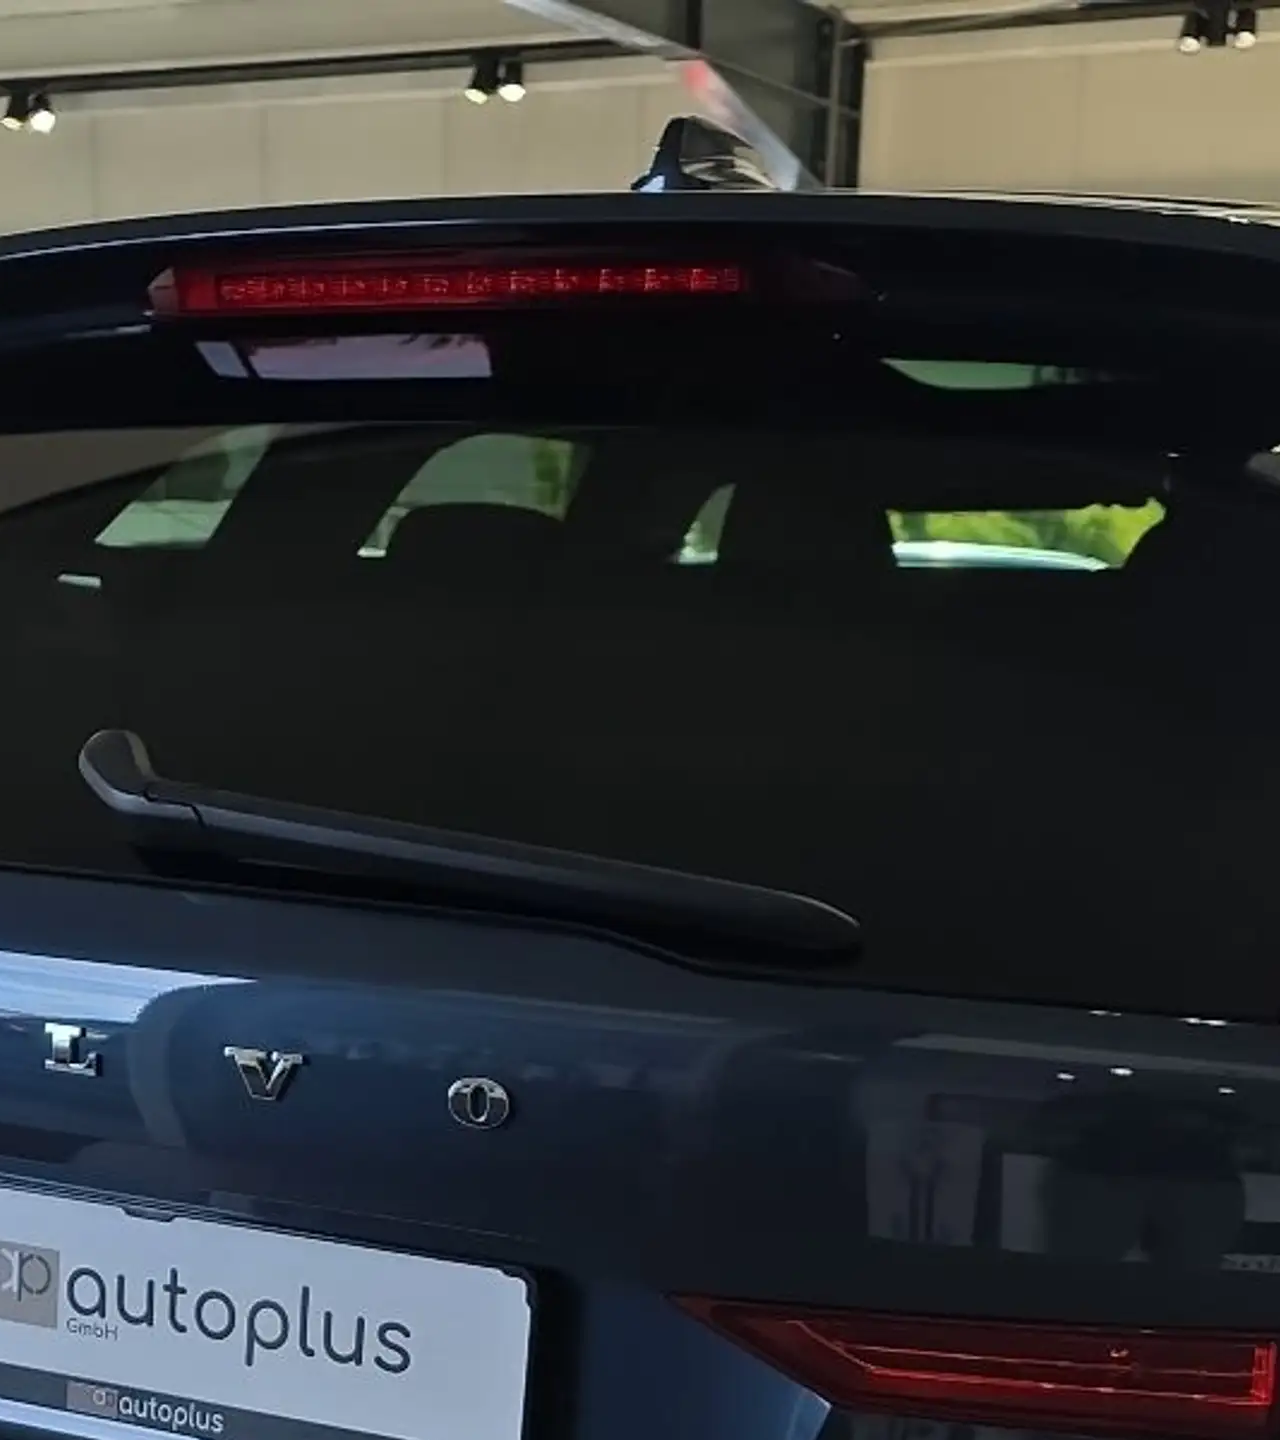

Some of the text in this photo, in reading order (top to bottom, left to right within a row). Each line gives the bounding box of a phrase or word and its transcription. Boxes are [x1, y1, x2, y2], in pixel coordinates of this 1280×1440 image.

[66, 1266, 412, 1374] autoplus
[66, 1317, 119, 1341] GmbH
[119, 1396, 225, 1433] autoplus
